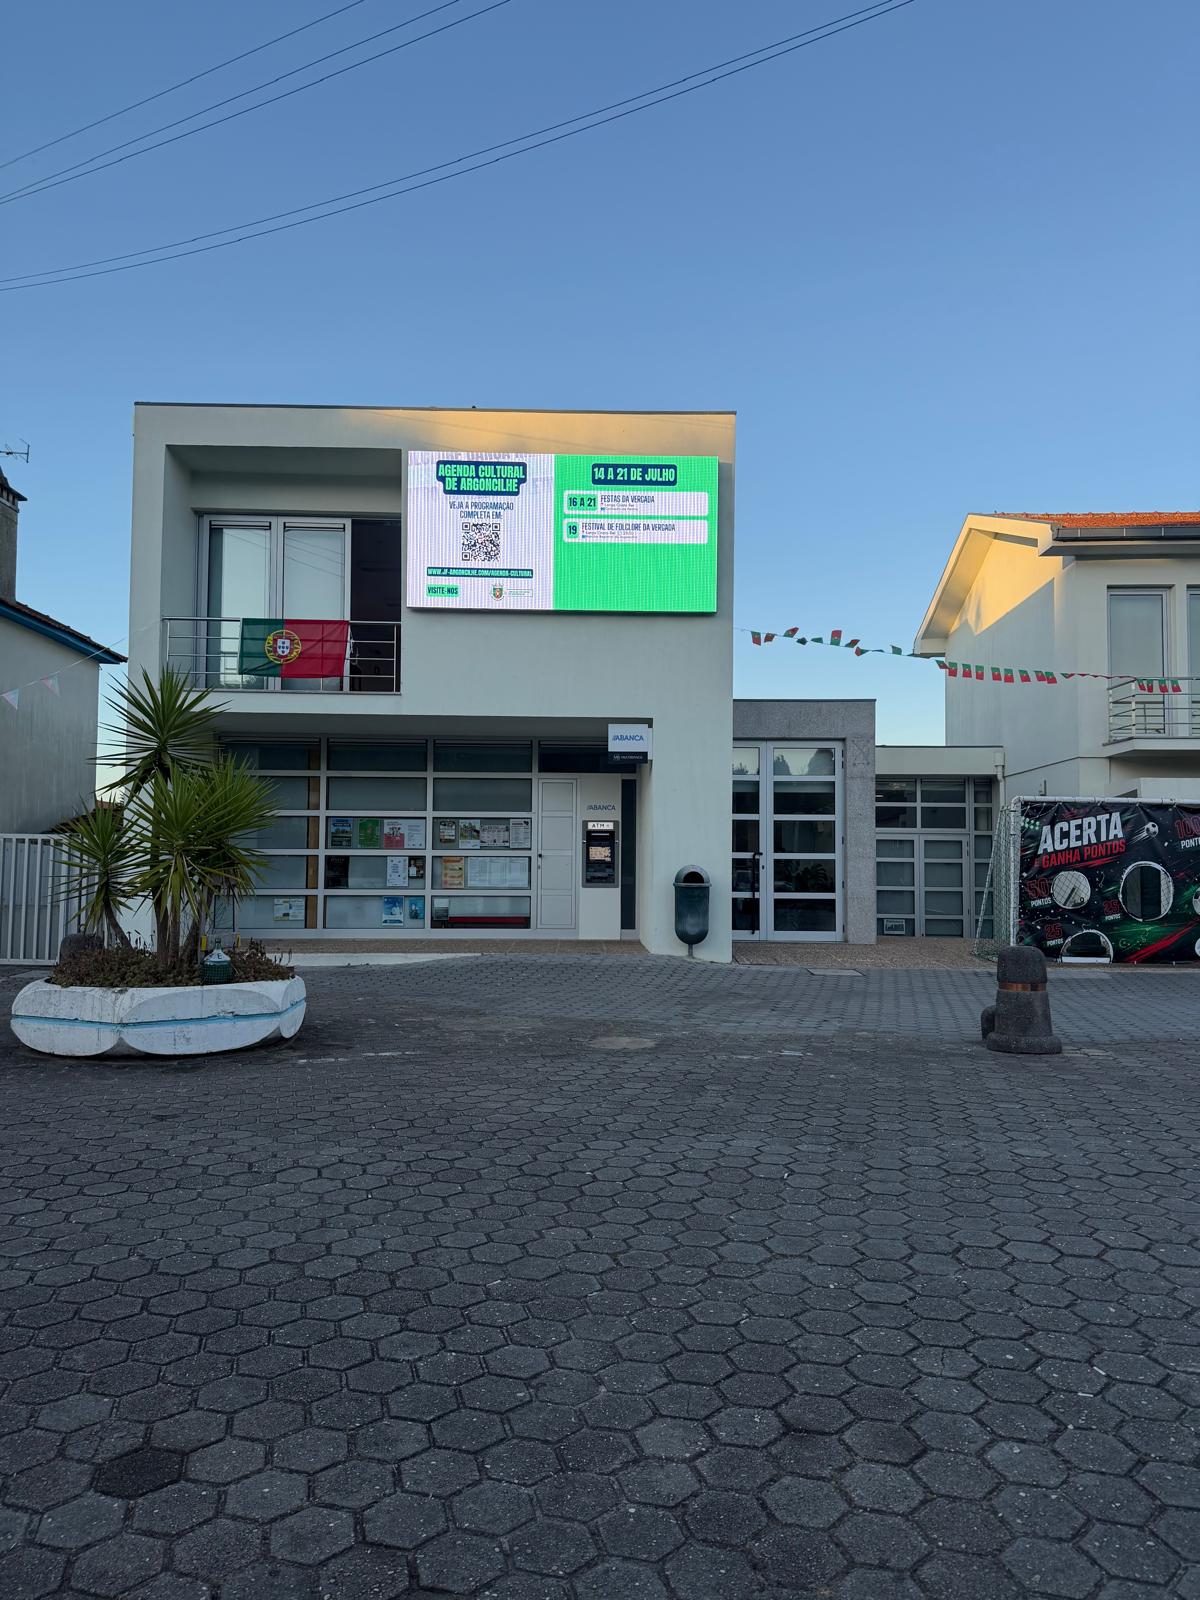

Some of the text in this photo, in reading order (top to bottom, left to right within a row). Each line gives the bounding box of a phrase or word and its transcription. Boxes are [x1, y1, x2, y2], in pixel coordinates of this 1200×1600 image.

[438, 464, 525, 478] AGENDA CULTURAL
[593, 467, 675, 481] 14 A 21 DE JULHO
[445, 478, 518, 491] DE ARGONCILHE
[569, 497, 596, 507] 16 A 21
[601, 495, 621, 503] FESTAS
[622, 495, 629, 503] DA
[449, 501, 463, 509] VEJA
[471, 501, 514, 511] PROGRAMAÇÃO
[460, 511, 490, 519] COMPLETA
[568, 525, 577, 535] 19
[607, 523, 614, 531] DE
[615, 523, 641, 531] FOLCLORE
[643, 523, 650, 531] DA
[427, 586, 459, 595] VISITE-NOS
[1037, 811, 1124, 854] ACERTA
[1042, 848, 1080, 869] GANHA
[1084, 839, 1126, 860] PONTOS
[1027, 878, 1050, 899] 50
[1031, 897, 1052, 907] PONTOS
[1045, 923, 1063, 939] 25
[1047, 938, 1064, 947] PONTOS
